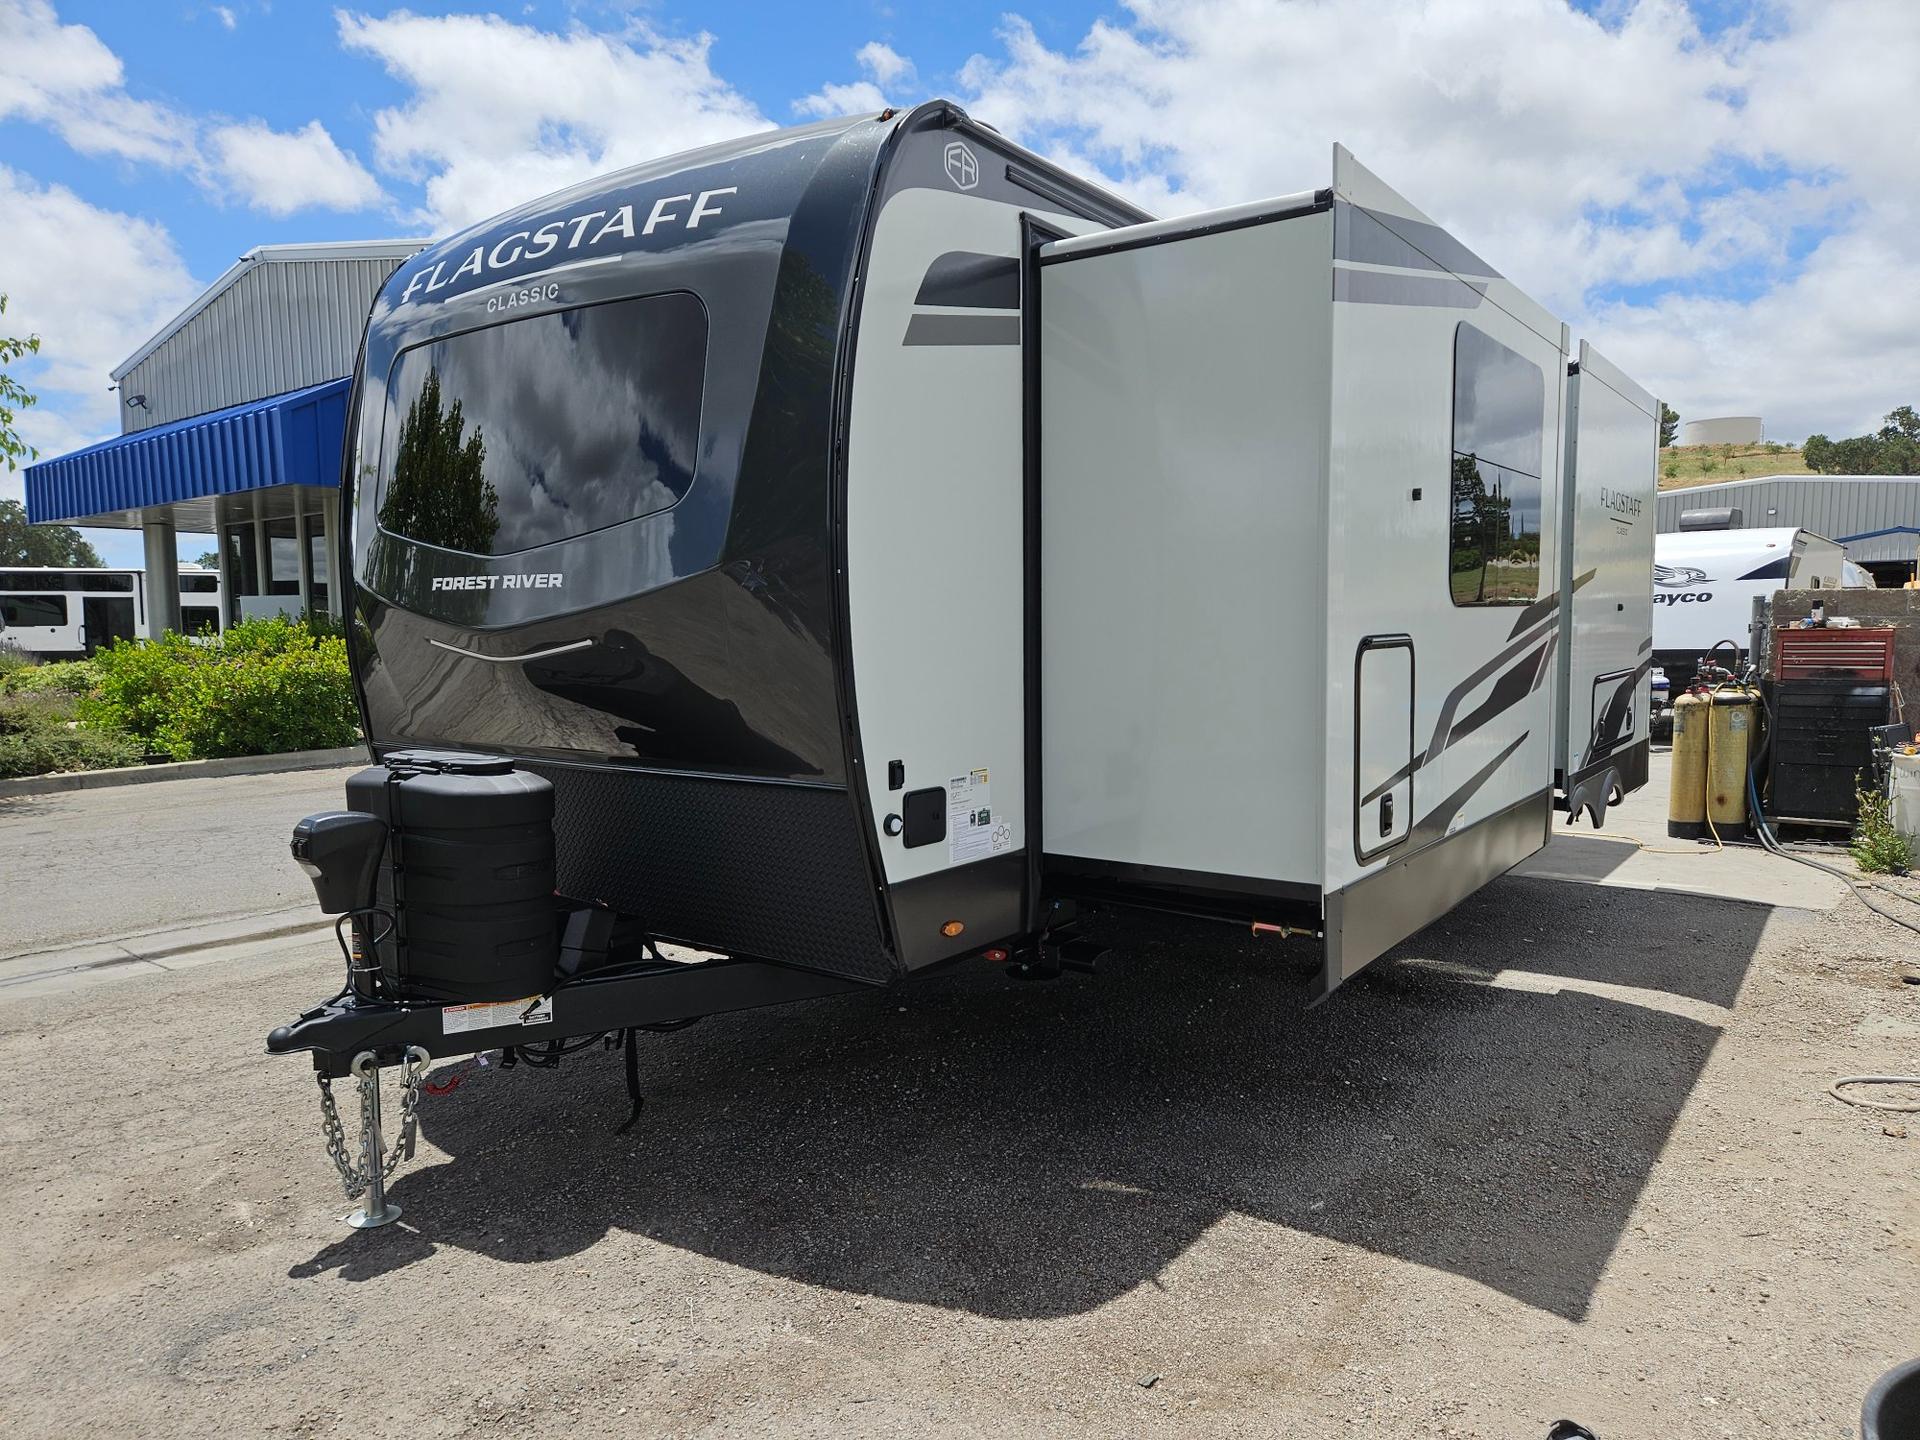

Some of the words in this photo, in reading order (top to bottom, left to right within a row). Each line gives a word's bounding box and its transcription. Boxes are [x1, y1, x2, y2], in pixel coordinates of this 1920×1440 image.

[402, 186, 738, 304] FLAGSTAFF
[487, 283, 559, 313] CLASSIC
[1600, 486, 1642, 518] FLAGSTAFF
[431, 575, 500, 591] FOREST
[502, 573, 563, 589] RIVER
[1653, 592, 1713, 607] ayco
